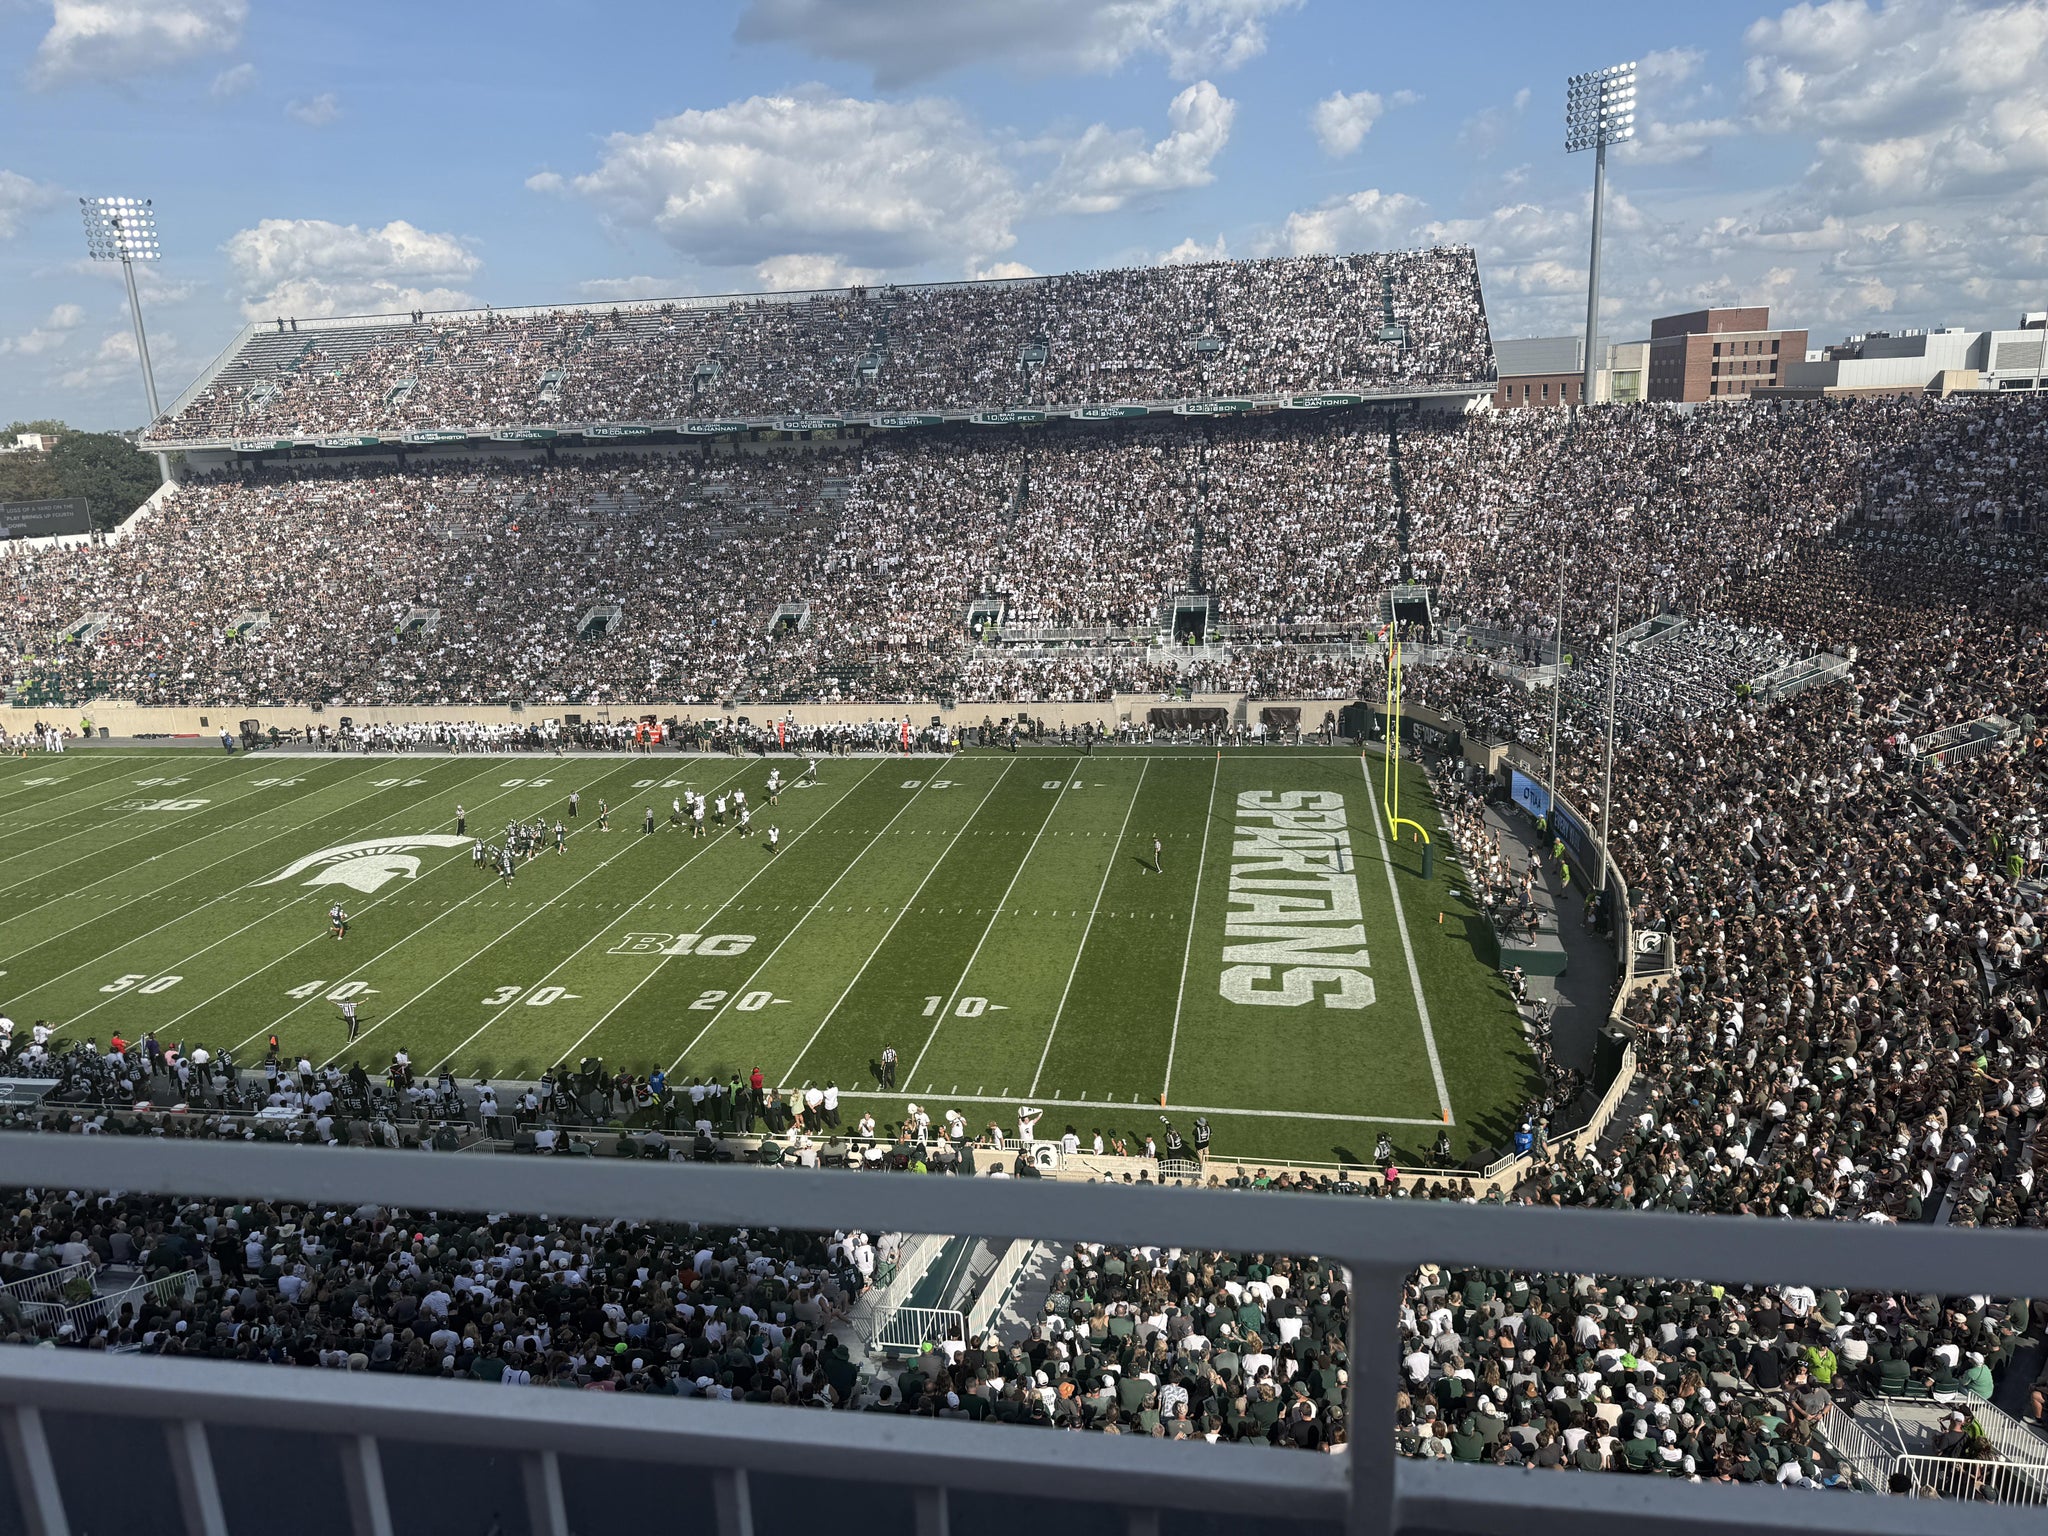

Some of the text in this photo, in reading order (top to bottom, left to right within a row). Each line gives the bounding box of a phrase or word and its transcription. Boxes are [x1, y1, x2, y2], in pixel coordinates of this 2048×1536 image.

[500, 779, 554, 787] 50
[900, 780, 952, 789] 20
[1042, 781, 1084, 789] 10
[1219, 790, 1377, 1010] SPARTANS
[99, 974, 184, 994] 50
[284, 980, 369, 1000] 40
[481, 986, 566, 1006] 30
[688, 990, 773, 1011] 20
[922, 996, 988, 1017] 10
[864, 1251, 869, 1262] 1
[1797, 1298, 1803, 1309] 1
